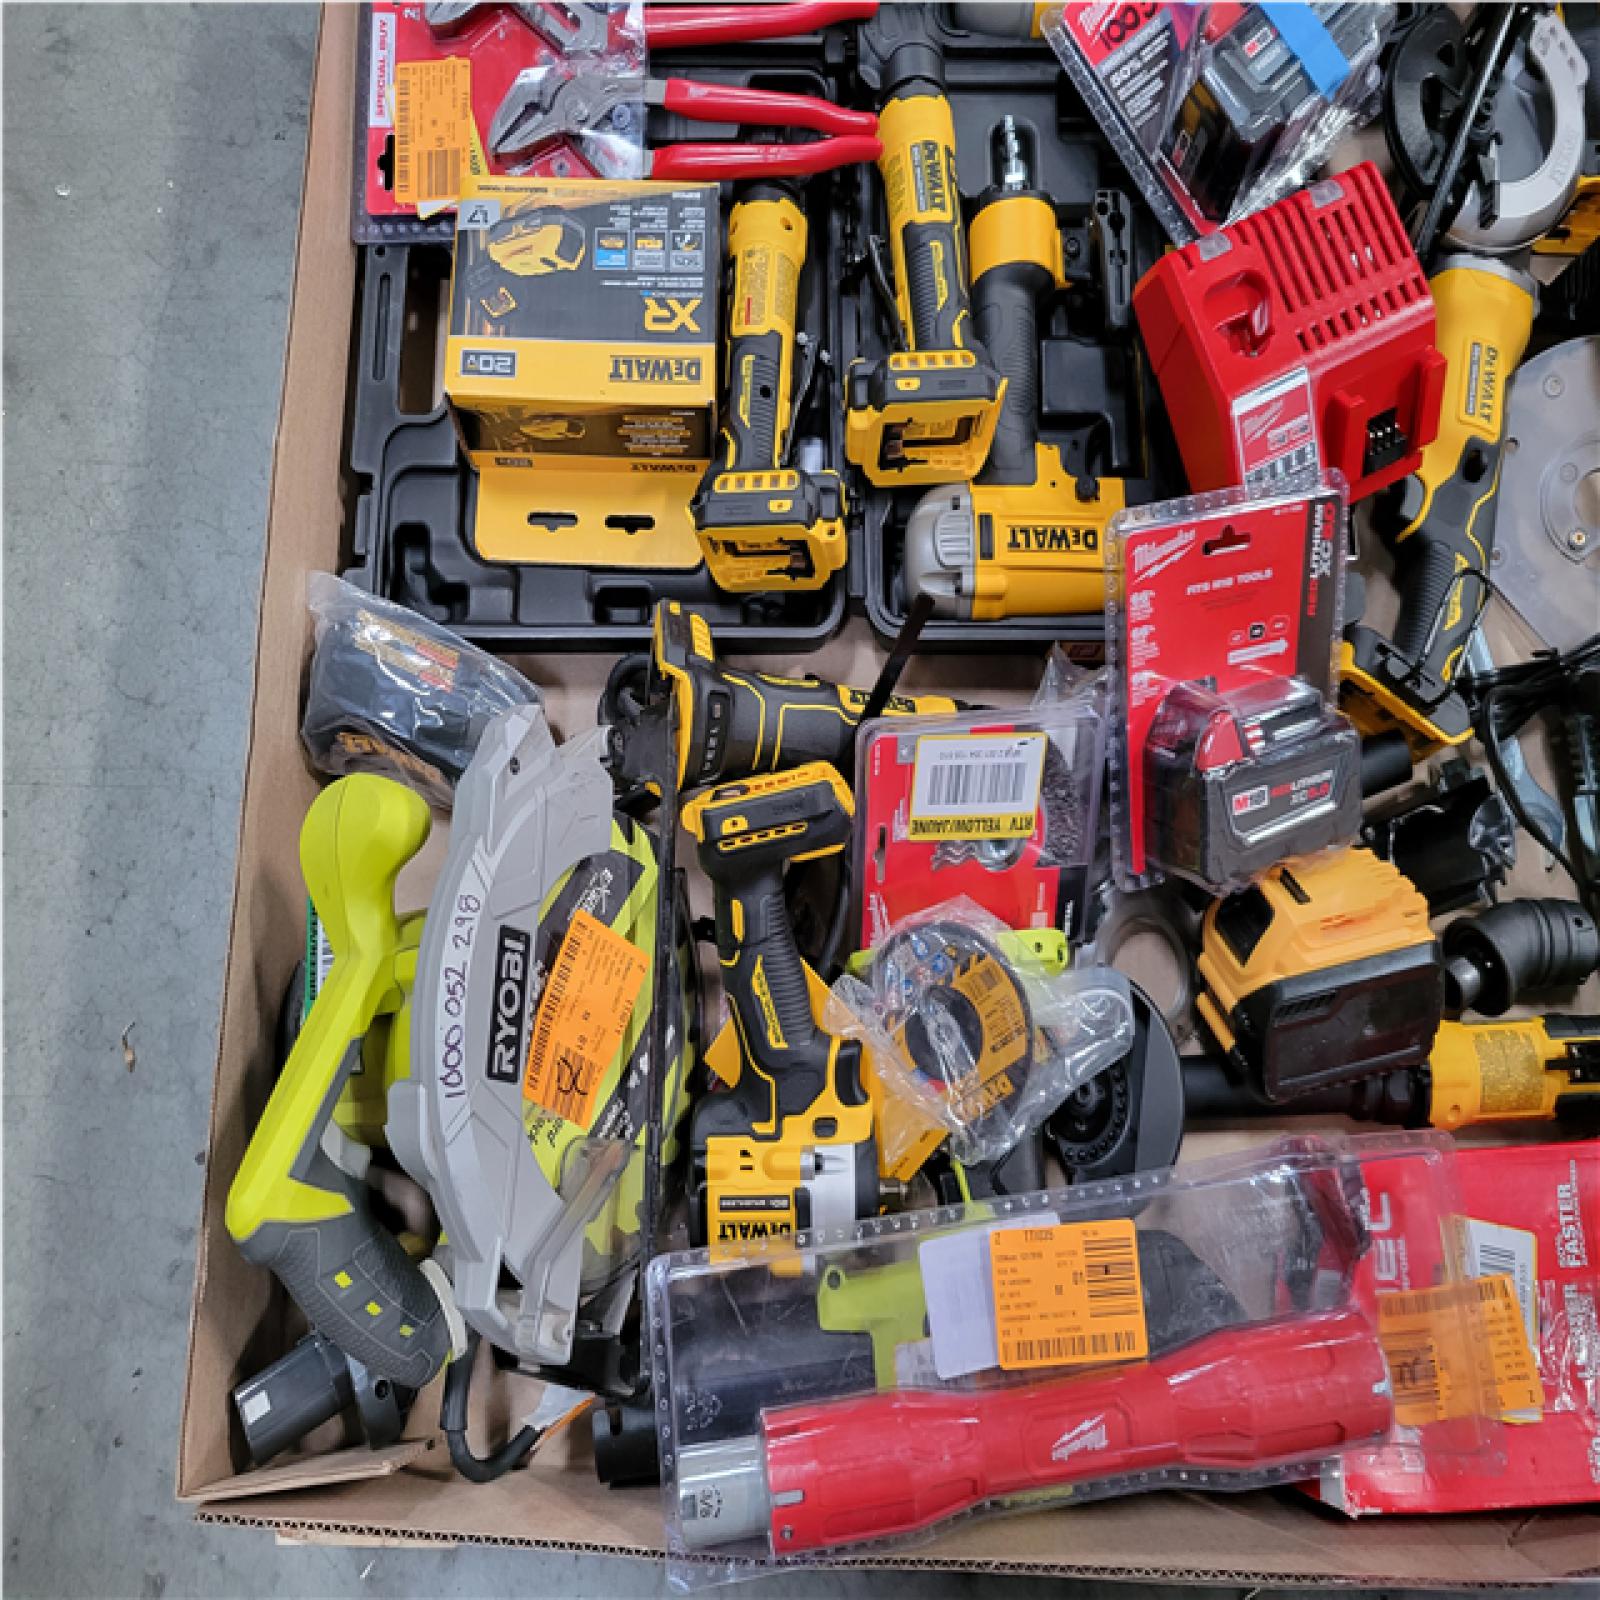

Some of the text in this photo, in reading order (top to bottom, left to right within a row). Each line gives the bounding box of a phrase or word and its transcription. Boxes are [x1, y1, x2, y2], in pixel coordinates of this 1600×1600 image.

[376, 18, 388, 117] SPECIAL BUY
[920, 140, 946, 212] DEWALT
[644, 298, 702, 333] XR
[609, 358, 702, 382] DEWALT
[1480, 344, 1497, 424] DEWALT
[1007, 525, 1098, 551] DEWALT
[1236, 567, 1274, 583] TOOLS
[1306, 503, 1323, 617] REDLITHIUM
[911, 816, 1033, 835] RTV YELLOW/JAUNE
[440, 894, 481, 1098] 1000 052 298
[493, 931, 527, 1075] RYOBI
[1557, 1184, 1588, 1268] FASTER
